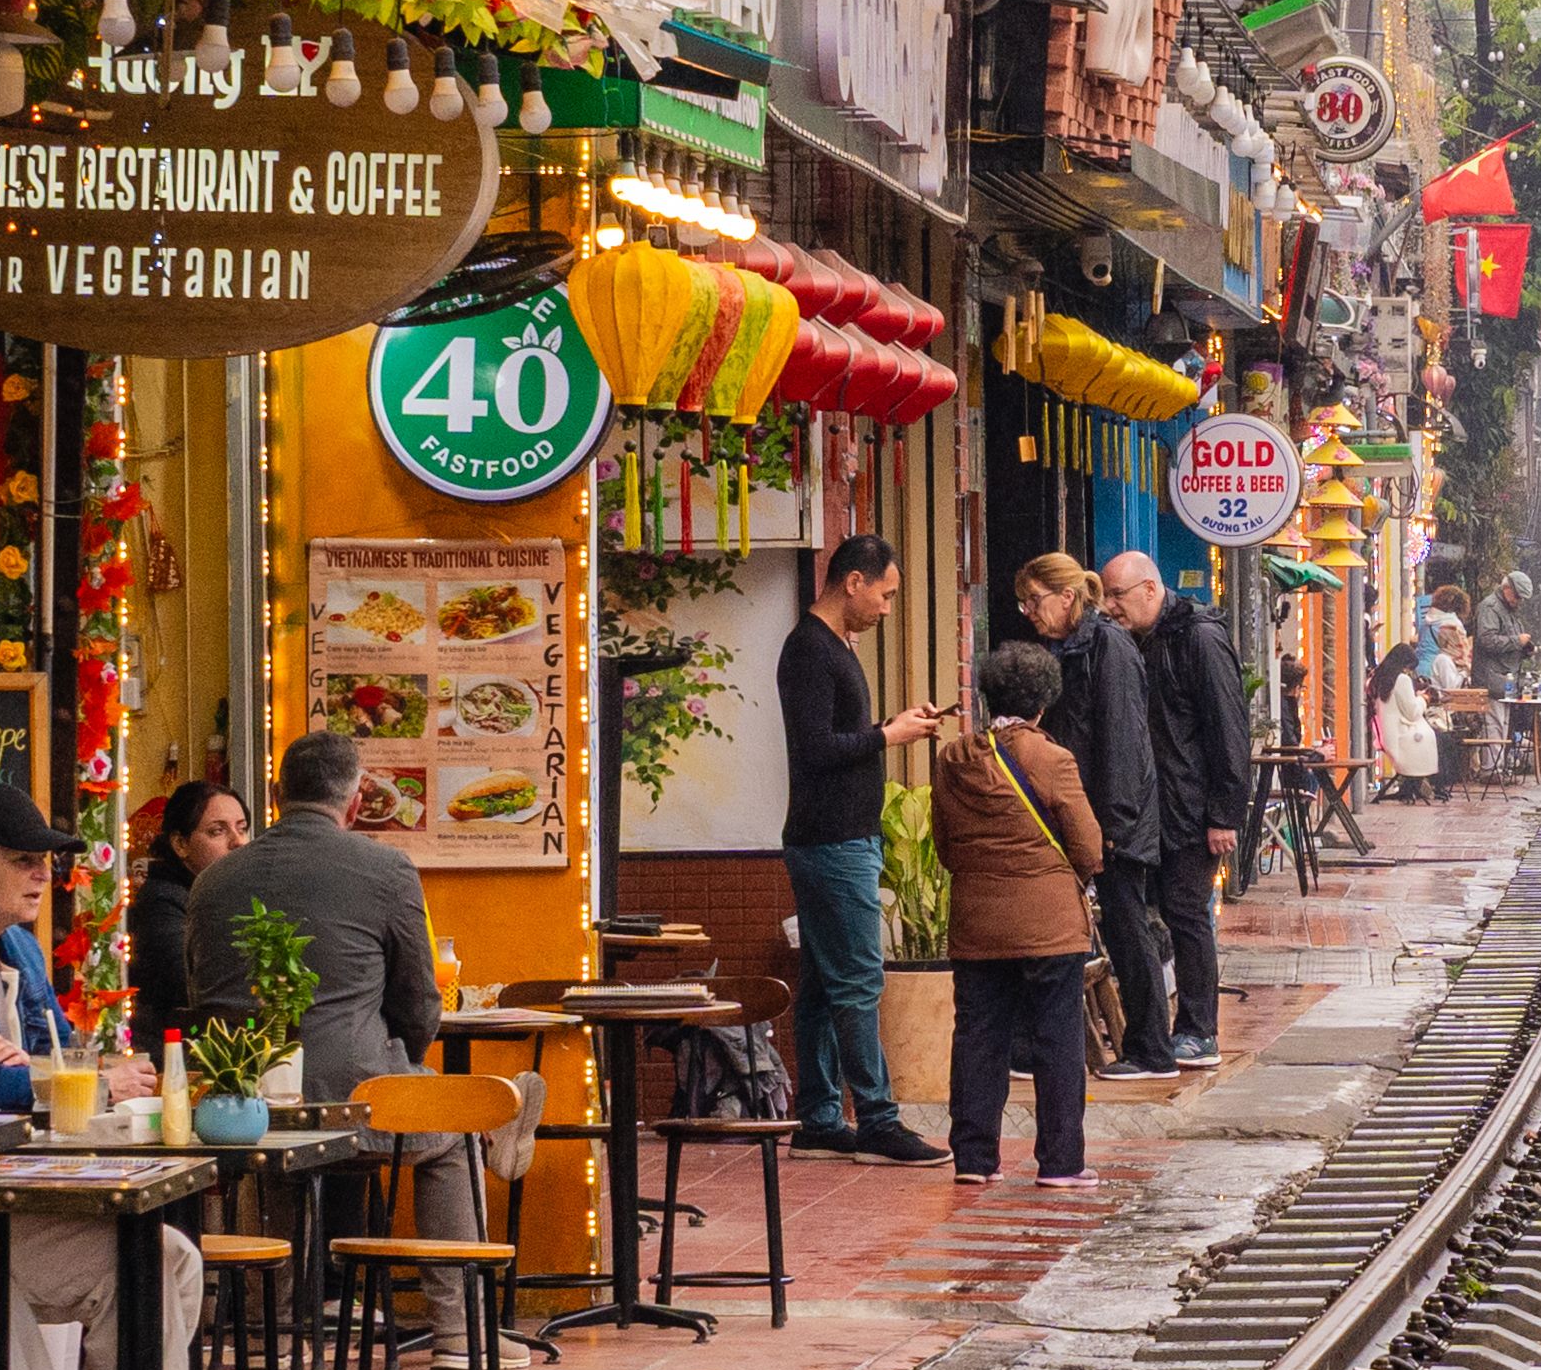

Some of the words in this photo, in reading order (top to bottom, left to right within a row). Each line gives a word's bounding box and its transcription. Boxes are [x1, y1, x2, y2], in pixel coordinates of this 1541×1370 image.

[1314, 67, 1344, 85] FAST
[1346, 69, 1377, 94] FOOD
[1316, 91, 1364, 125] 30
[1325, 136, 1358, 148] FFEE
[76, 146, 280, 215] RESTAURANT
[288, 165, 316, 215] &
[325, 151, 444, 218] COFFEE
[401, 336, 571, 435] 40
[420, 434, 555, 480] FASTFOOD
[1194, 440, 1275, 468] GOLD
[1181, 475, 1232, 494] COFFEE
[1235, 475, 1246, 494] &
[1250, 475, 1285, 493] BEER
[1218, 498, 1248, 518] 32
[325, 549, 408, 569] VIETNAMESE
[412, 549, 493, 568] TRADITIONAL
[497, 549, 550, 567] CUISINE
